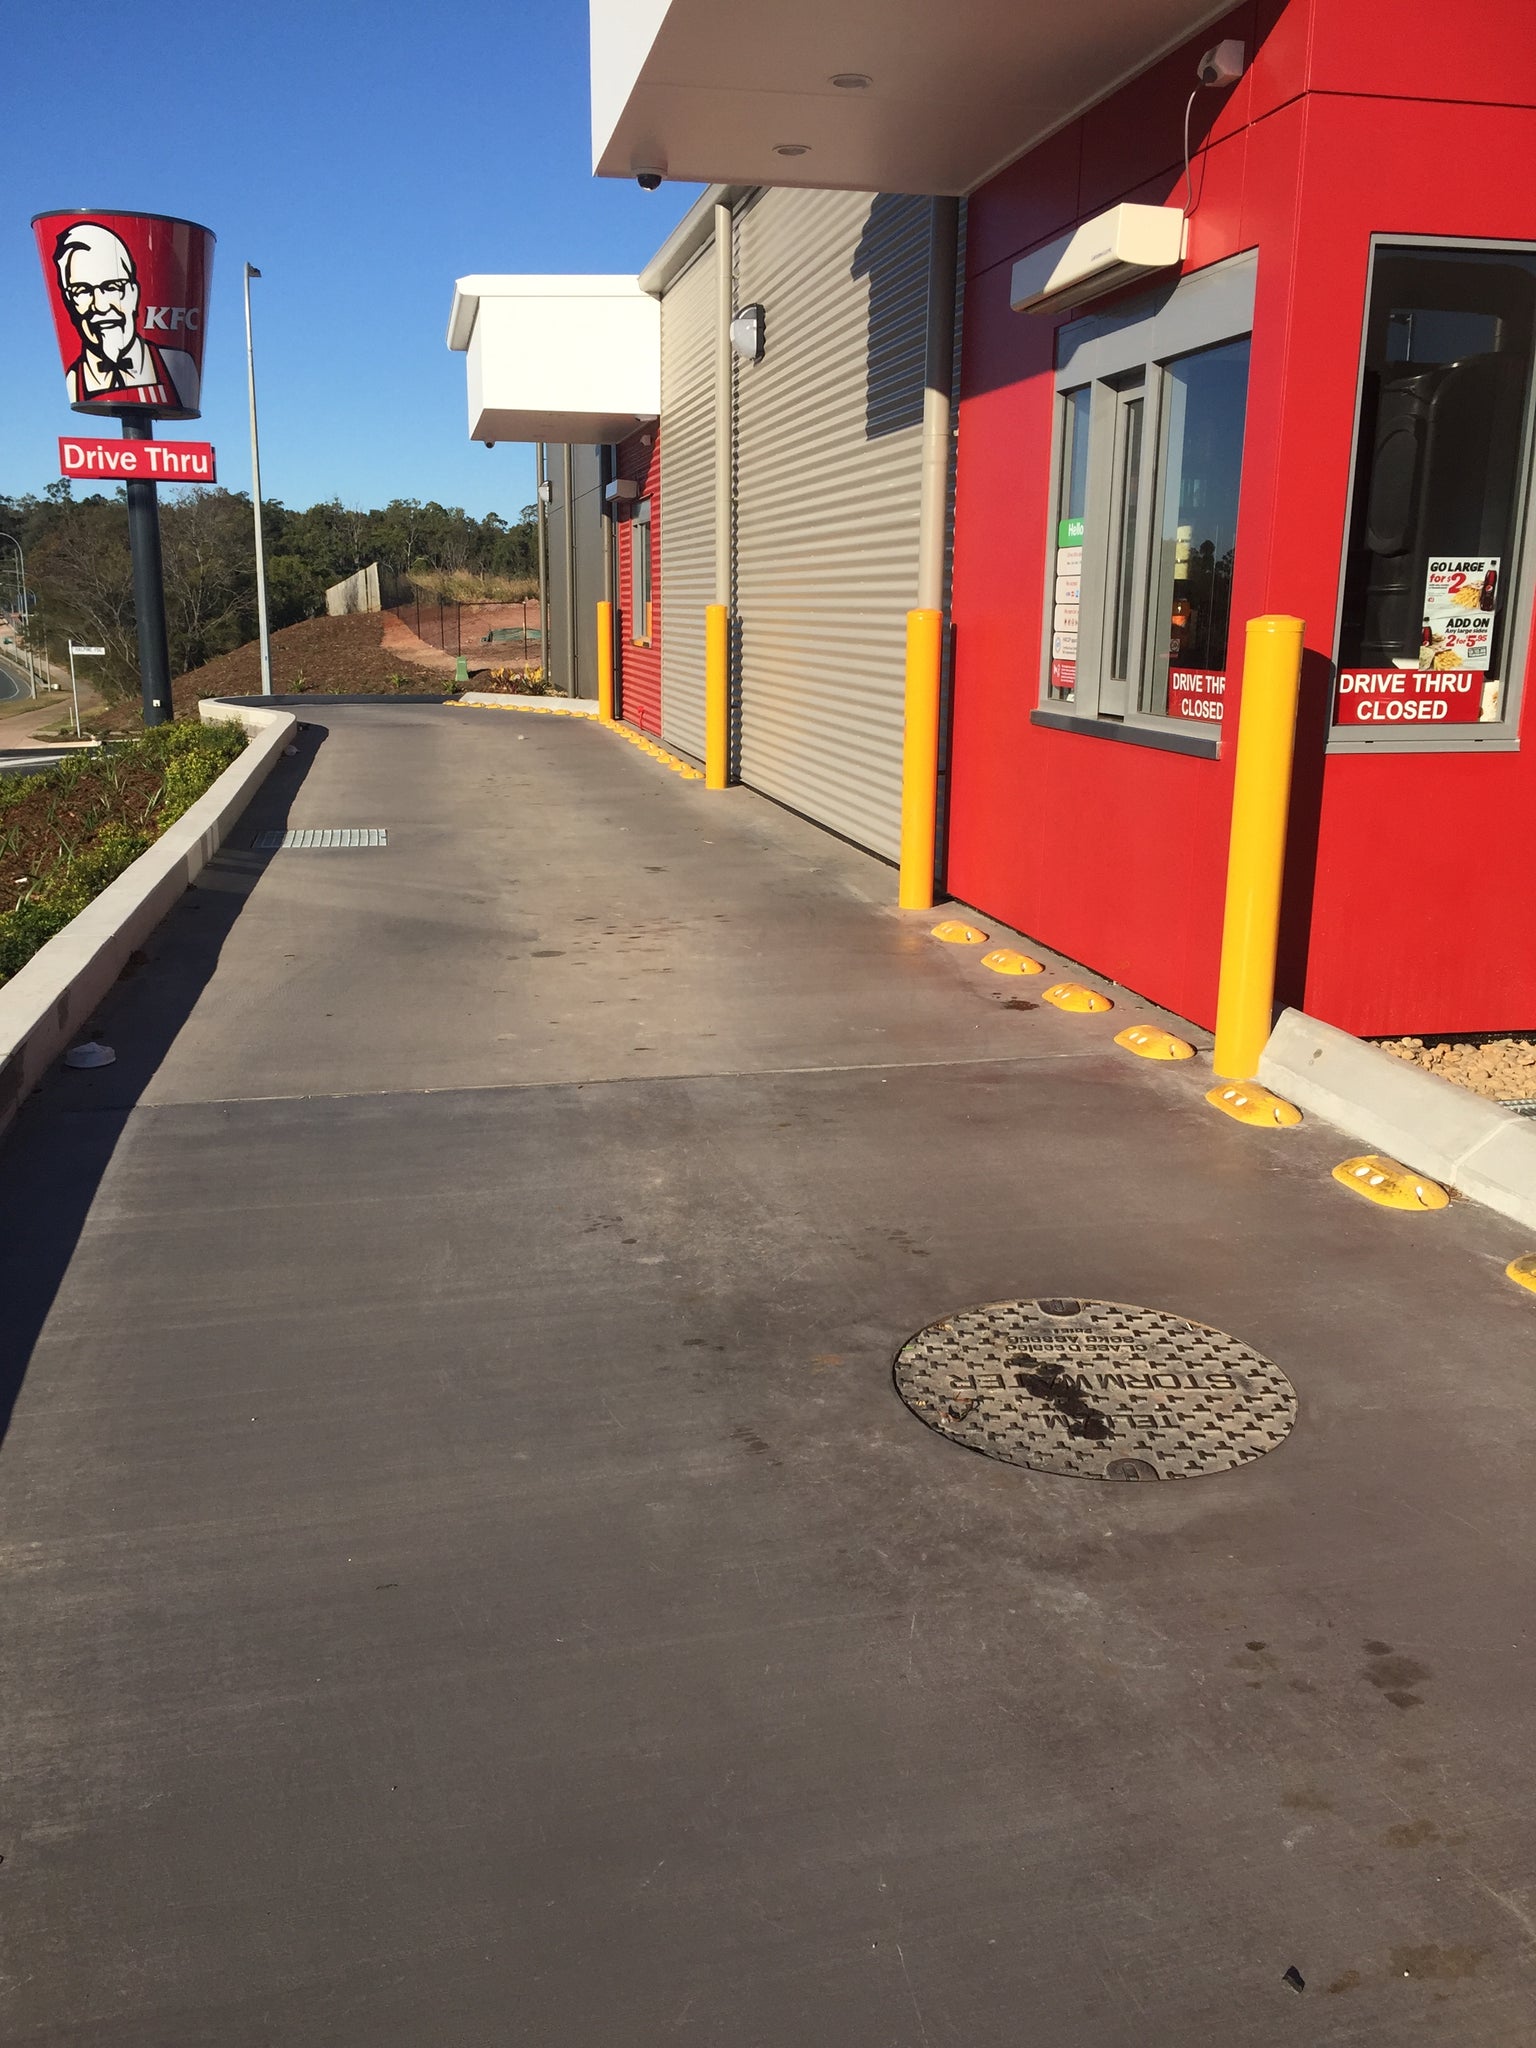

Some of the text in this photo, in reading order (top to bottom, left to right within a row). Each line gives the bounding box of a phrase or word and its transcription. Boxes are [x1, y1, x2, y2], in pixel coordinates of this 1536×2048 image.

[143, 305, 199, 331] KFC
[63, 444, 208, 474] Drive Thru
[1430, 561, 1485, 572] GO LARGE
[1429, 573, 1446, 583] for
[1446, 617, 1490, 628] ADD ON
[1445, 634, 1457, 648] 2
[1173, 672, 1203, 693] DRIVE
[1339, 673, 1472, 694] DRIVE THRU
[1181, 697, 1224, 720] CLOSED
[1356, 700, 1448, 720] CLOSED
[1085, 1344, 1148, 1352] CLASS
